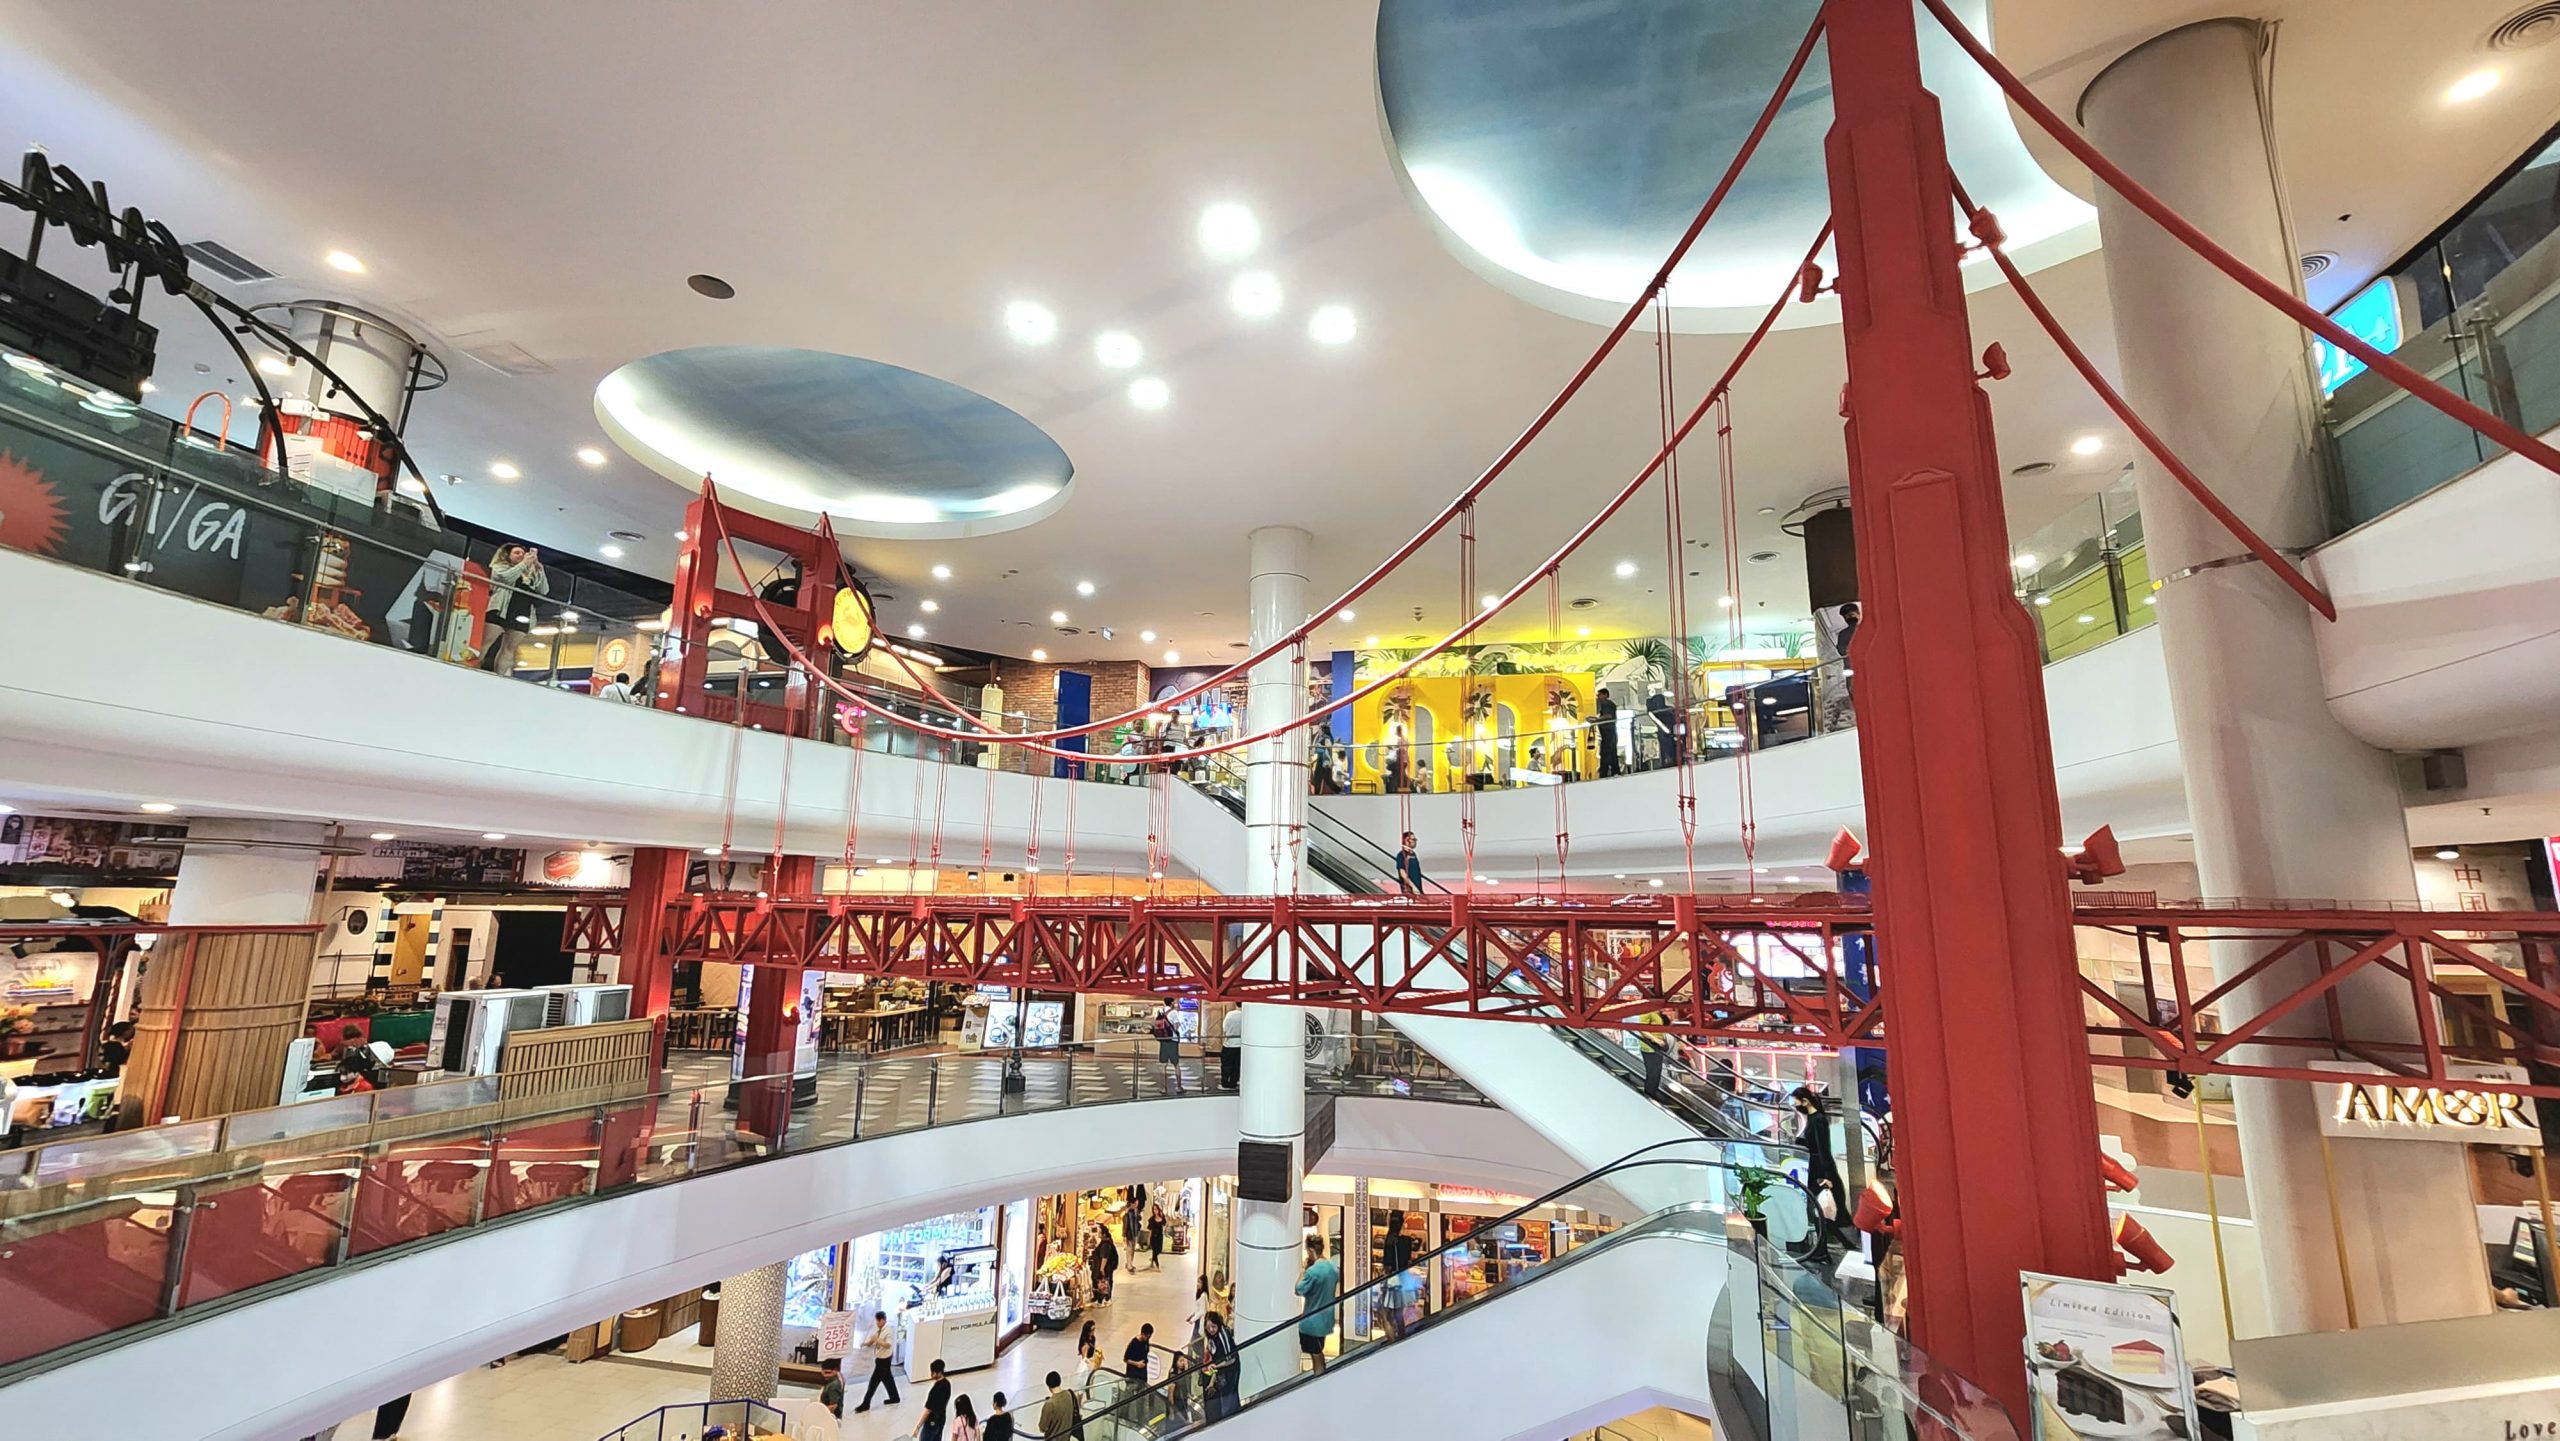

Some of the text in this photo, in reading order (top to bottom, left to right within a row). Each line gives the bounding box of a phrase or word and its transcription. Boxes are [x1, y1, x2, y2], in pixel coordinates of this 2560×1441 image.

[99, 473, 246, 560] GI/GA
[906, 1226, 967, 1243] FORMULA
[2050, 1299, 2151, 1320] Limited Edition
[825, 1329, 849, 1340] 25%
[825, 1340, 848, 1350] OFF
[2505, 1420, 2556, 1441] Love
